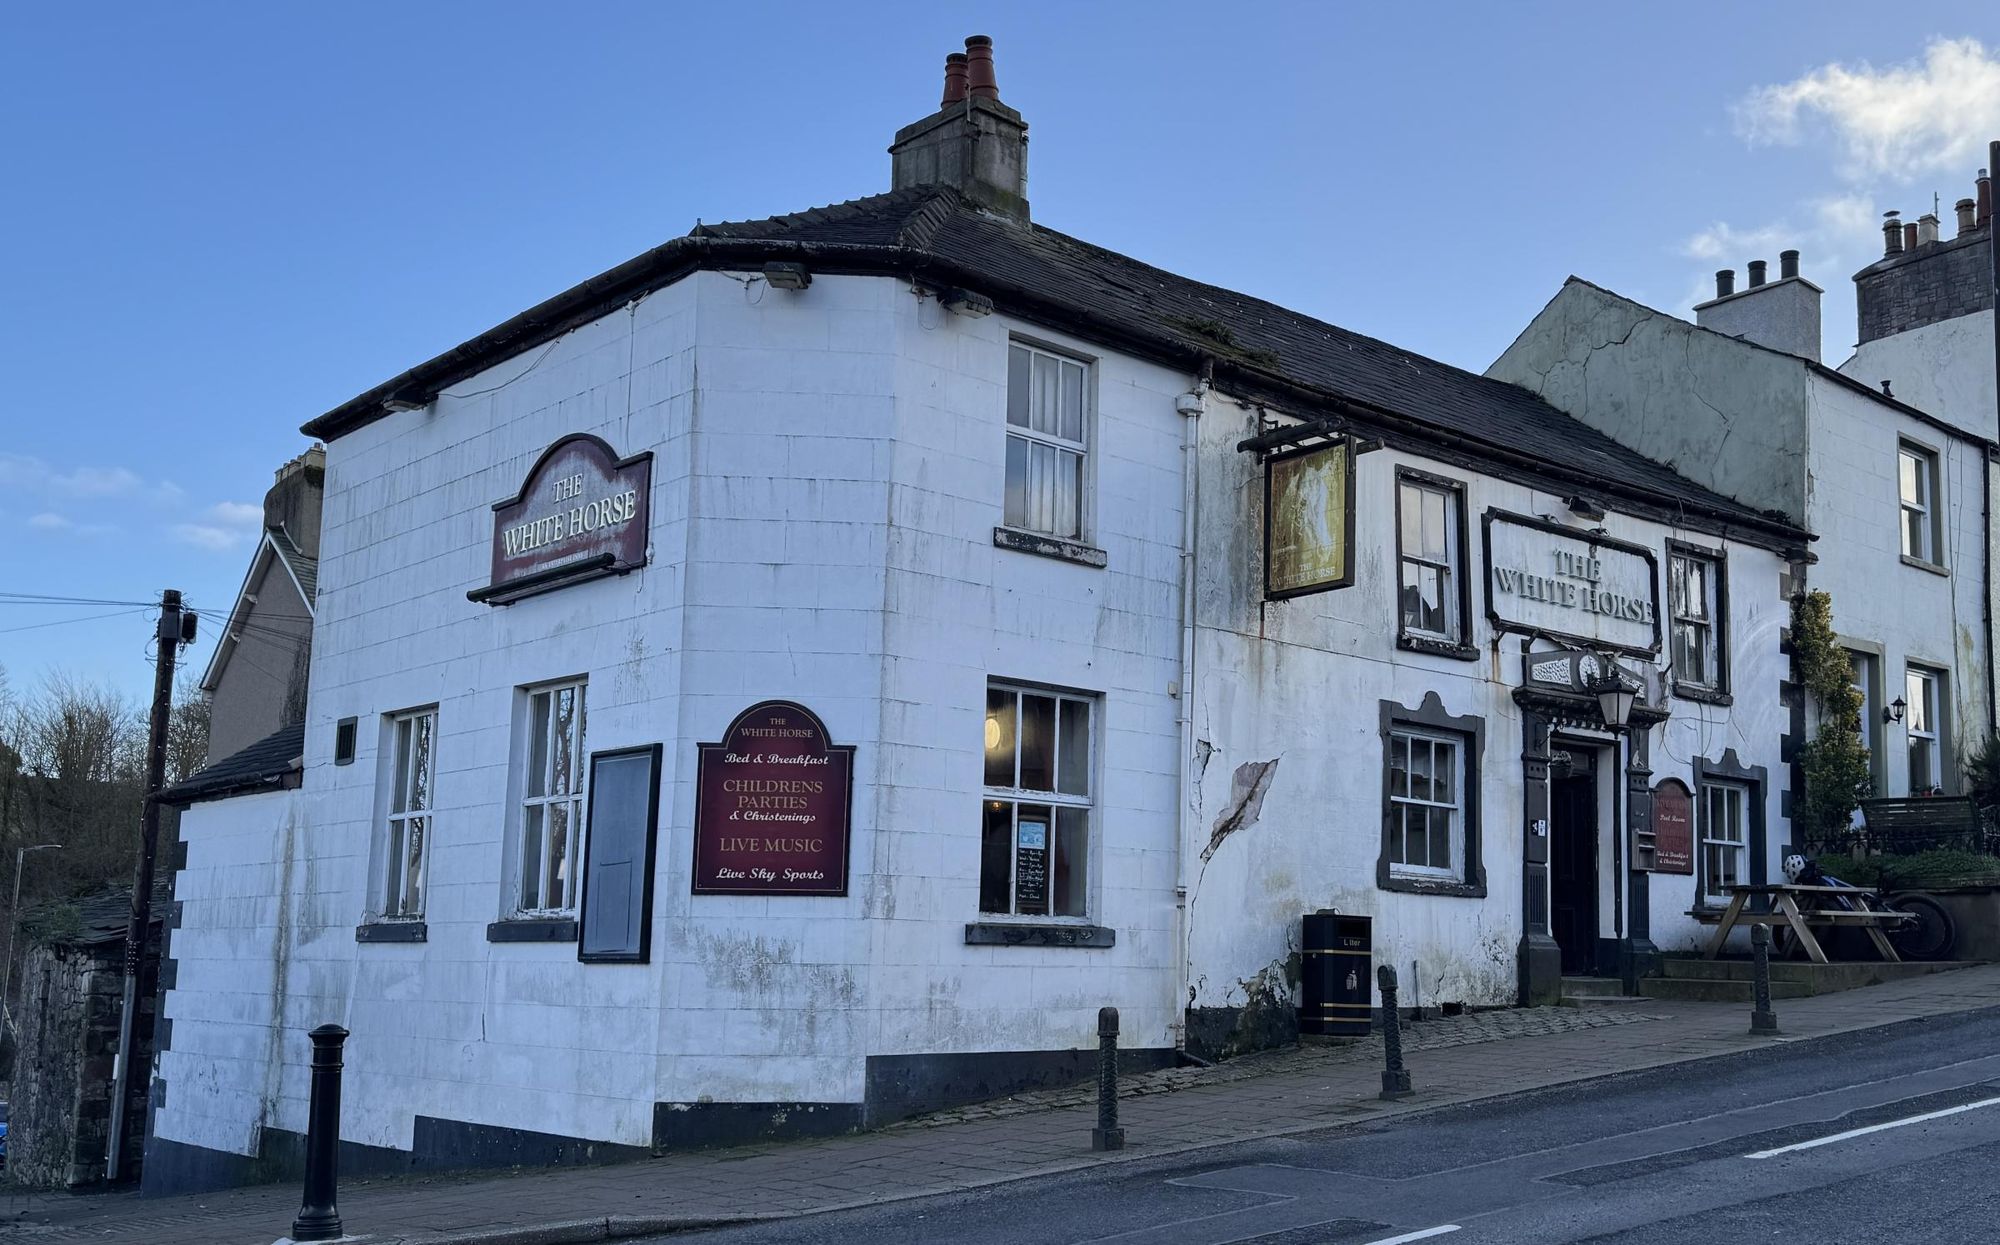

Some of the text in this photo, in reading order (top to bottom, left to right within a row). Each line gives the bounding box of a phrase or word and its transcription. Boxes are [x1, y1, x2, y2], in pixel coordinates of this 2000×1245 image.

[552, 473, 583, 504] THE
[503, 490, 636, 556] WHITE HORSE
[1299, 563, 1312, 572] THE
[1308, 566, 1336, 580] HORSE
[1555, 550, 1601, 583] THE
[1493, 566, 1655, 625] WHITE HORSE
[741, 728, 814, 738] WHITE HORSE
[724, 752, 829, 767] Bed & Breakfast
[723, 779, 823, 793] CHILDRENS
[738, 796, 808, 809] PARTIES
[729, 810, 816, 824] & Christenings
[720, 838, 823, 853] LIVE MUSIC
[716, 868, 824, 882] Live Sky Sports
